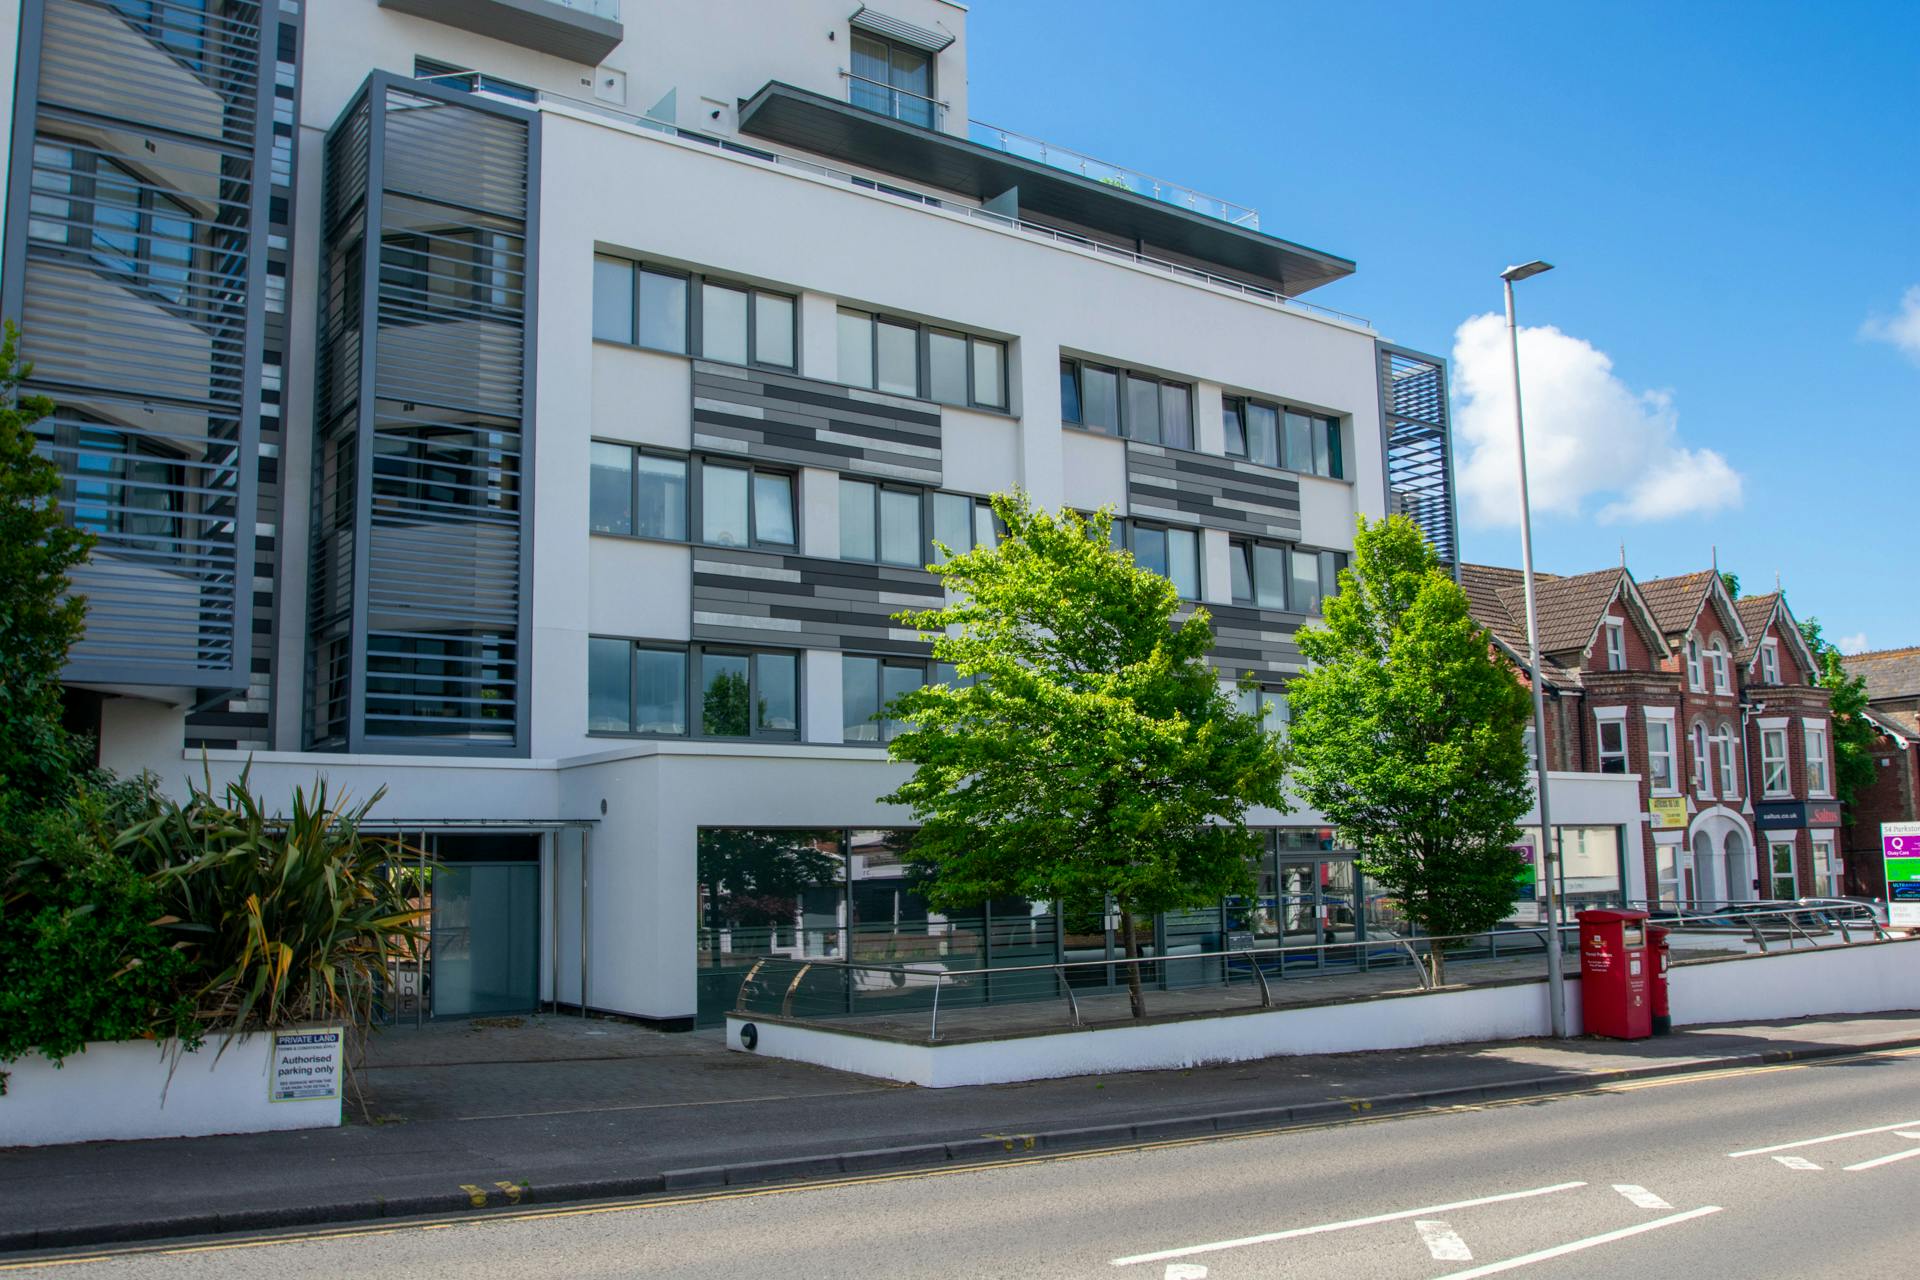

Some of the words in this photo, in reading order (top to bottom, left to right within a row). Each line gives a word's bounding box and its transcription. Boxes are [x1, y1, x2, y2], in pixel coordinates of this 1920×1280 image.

[279, 1036, 313, 1045] PRIVATE
[314, 1034, 336, 1043] LAND
[282, 1054, 332, 1065] Authorised
[278, 1066, 312, 1077] parking
[314, 1065, 335, 1074] only
